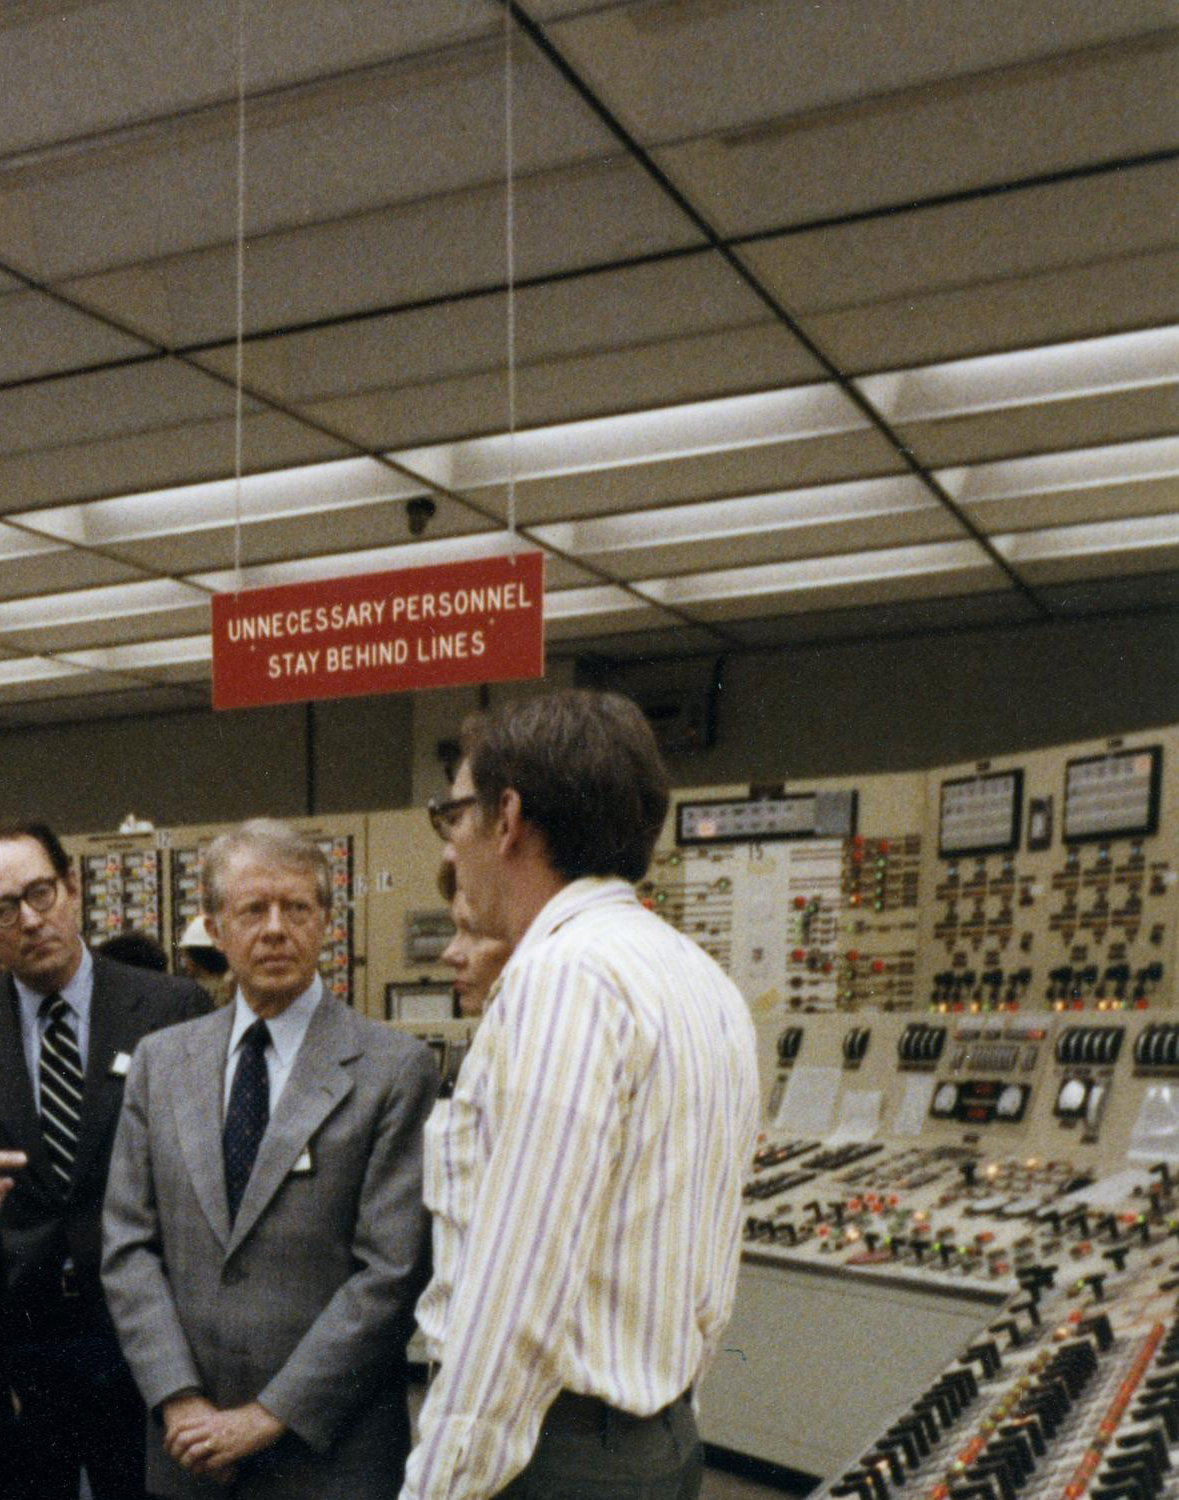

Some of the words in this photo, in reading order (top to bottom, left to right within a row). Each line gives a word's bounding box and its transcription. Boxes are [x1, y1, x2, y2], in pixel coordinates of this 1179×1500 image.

[228, 601, 386, 642] UNNECESSARY
[392, 582, 531, 621] PERSONNEL
[268, 651, 319, 679] STAY
[326, 639, 409, 672] BEHIND
[417, 631, 485, 661] LINES
